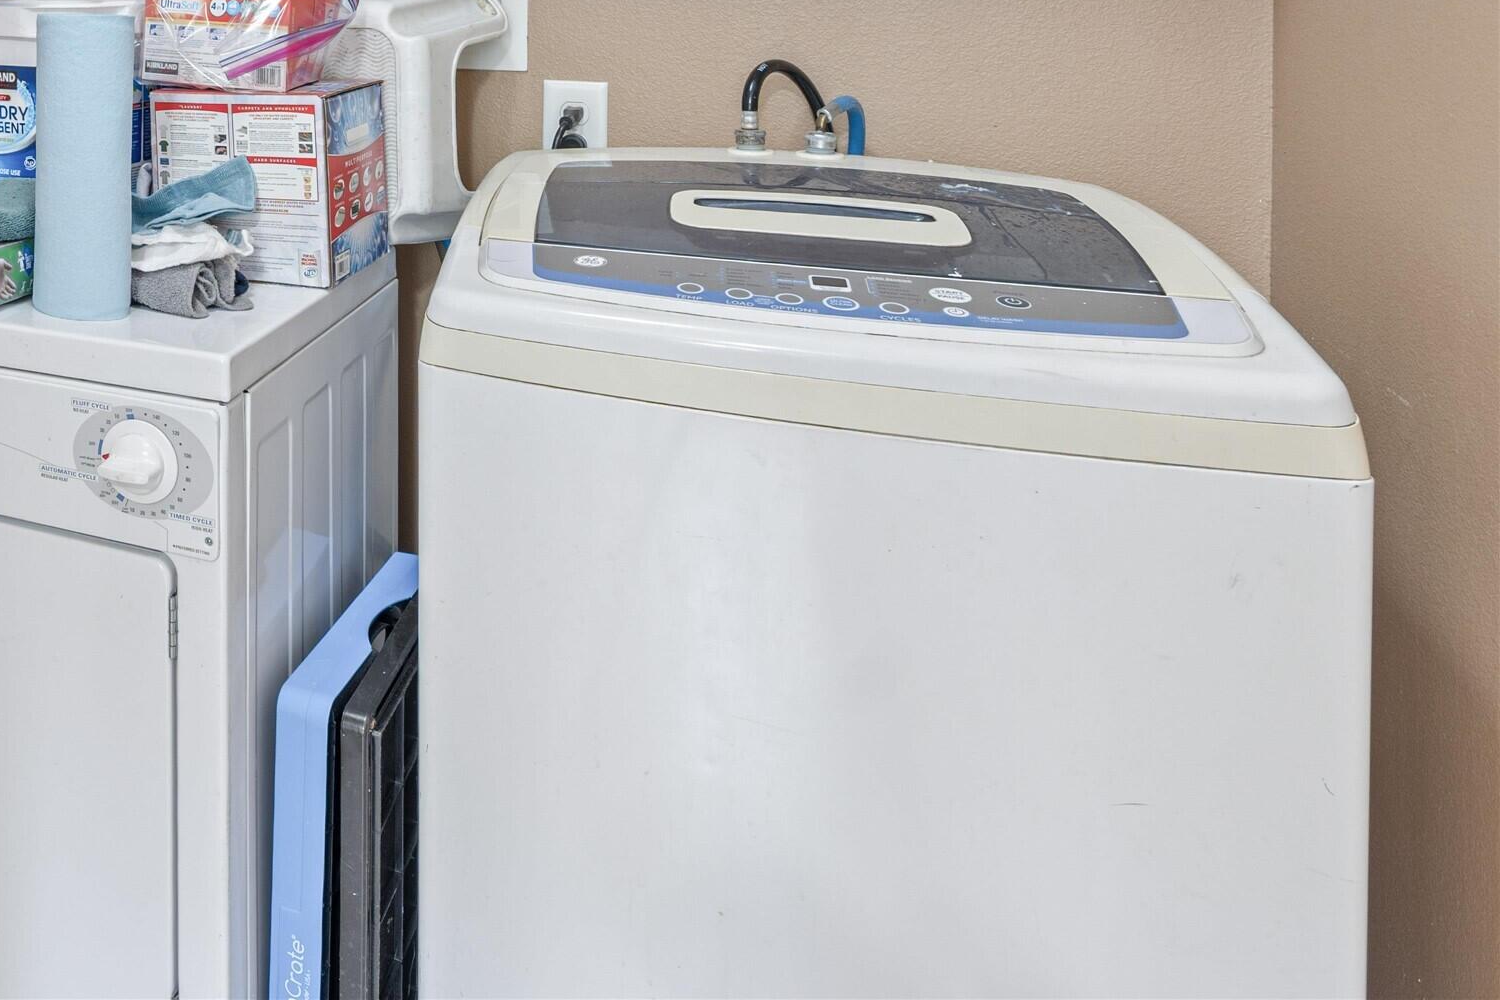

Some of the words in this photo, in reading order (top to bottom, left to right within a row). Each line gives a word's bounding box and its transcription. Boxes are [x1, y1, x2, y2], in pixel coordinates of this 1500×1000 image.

[160, 0, 199, 10] UltraSoft
[146, 61, 178, 71] KIRKLAND
[725, 299, 755, 307] LOAD
[770, 304, 819, 313] OPTIONS
[879, 314, 922, 323] CYCLES
[72, 400, 90, 408] FLUFF
[91, 402, 110, 411] CYCLE
[41, 465, 77, 478] AUTOMATIC
[77, 472, 97, 481] CYCLE
[169, 512, 191, 522] TIMED
[192, 516, 213, 526] CYCLE
